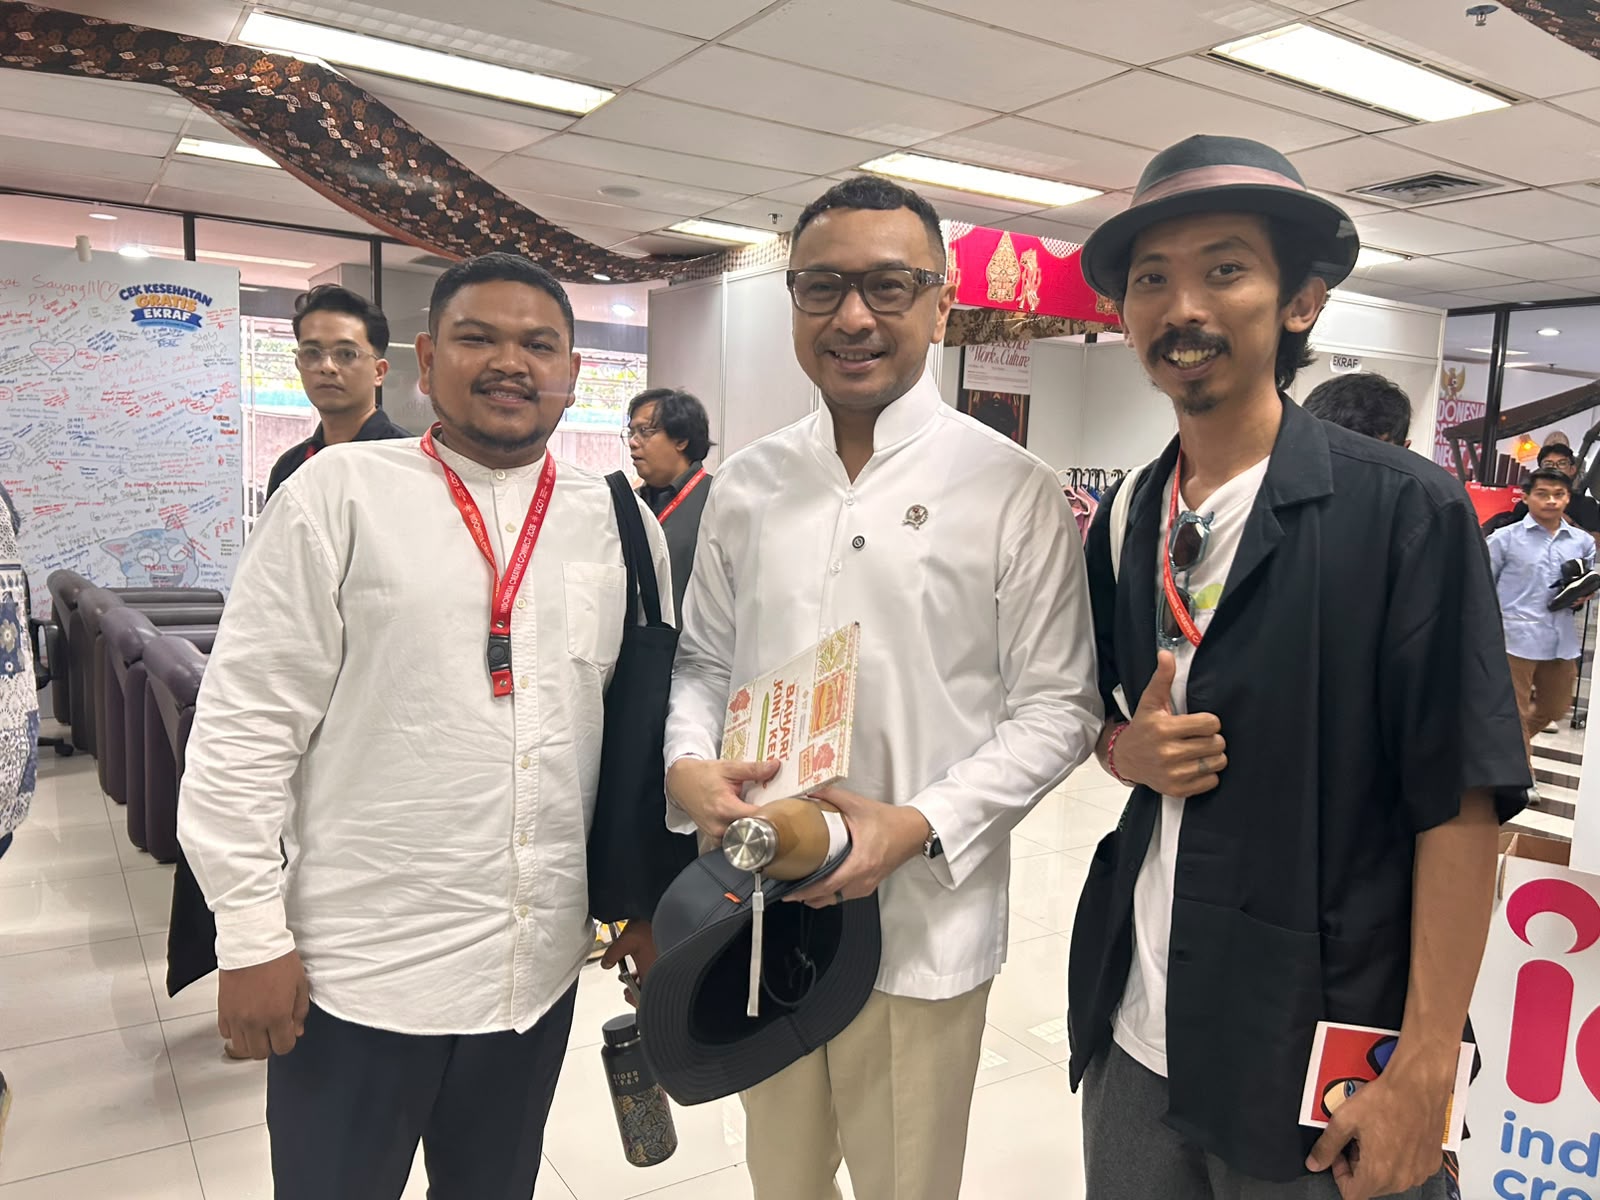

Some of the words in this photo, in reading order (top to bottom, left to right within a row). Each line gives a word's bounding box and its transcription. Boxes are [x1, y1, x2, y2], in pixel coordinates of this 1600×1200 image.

[119, 285, 143, 301] CEK
[143, 283, 213, 307] KESEHATAN
[135, 294, 197, 313] GRATIS
[143, 308, 192, 321] EKRAF
[974, 345, 997, 364] Work
[1000, 349, 1030, 367] Culture
[1332, 355, 1359, 369] EKRAF
[500, 585, 515, 614] INDONESIA
[509, 561, 523, 586] CREATIVE
[517, 536, 532, 563] CONNECT
[778, 683, 796, 761] BAHARI
